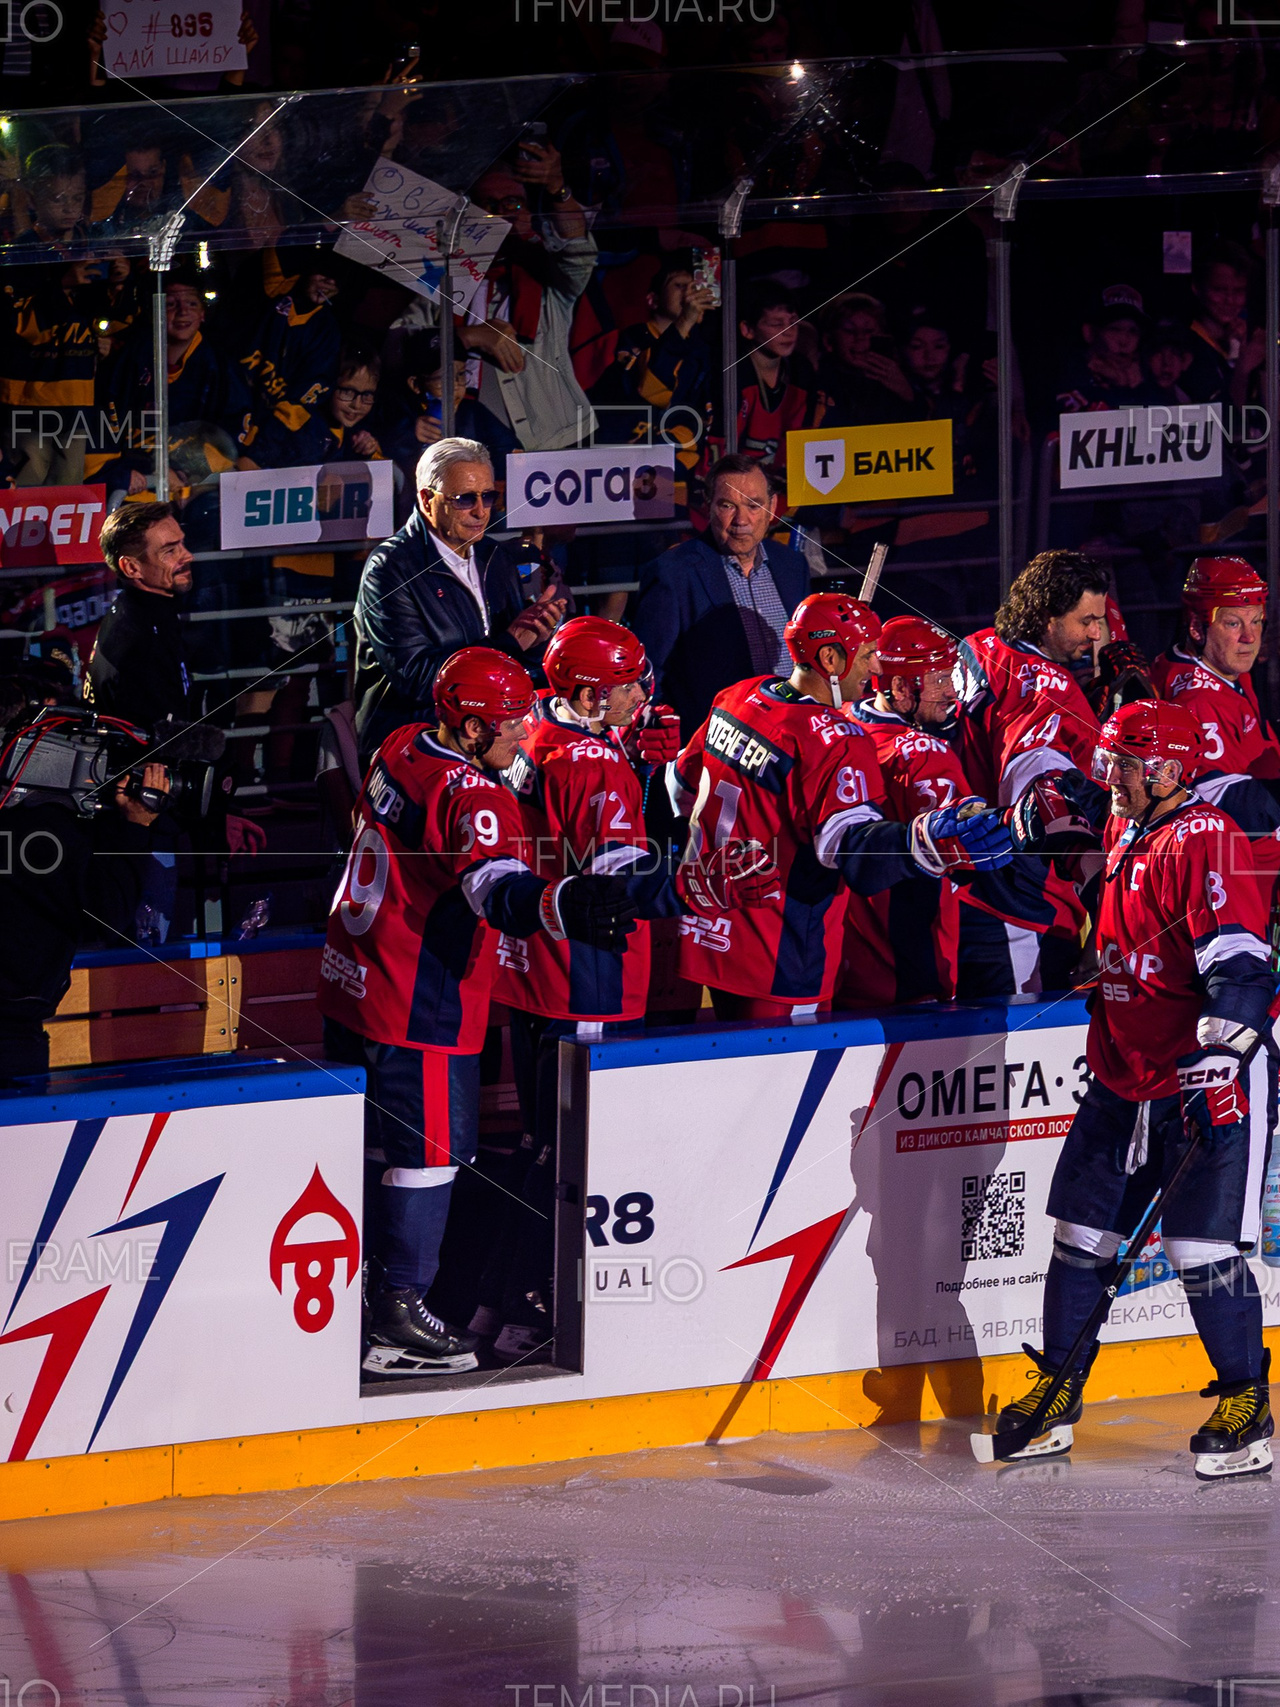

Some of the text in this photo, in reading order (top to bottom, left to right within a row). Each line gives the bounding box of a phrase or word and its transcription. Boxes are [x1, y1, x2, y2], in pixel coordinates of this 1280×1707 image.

[142, 10, 213, 41] #895
[111, 43, 233, 72] ДАЙ ШАЙБУ
[1069, 421, 1215, 470] KHL.RU
[853, 446, 936, 476] БАНК
[245, 487, 370, 526] SIBUR
[574, 674, 600, 682] CCM
[460, 700, 486, 708] CCM
[820, 722, 865, 746] FON
[1167, 743, 1190, 751] CCM
[572, 745, 620, 764] FON
[900, 737, 948, 761] FON
[836, 766, 869, 804] 81
[589, 791, 632, 833] 72
[458, 809, 499, 852] 39
[1175, 817, 1225, 843] FON
[1205, 870, 1227, 911] 8
[1177, 1066, 1231, 1088] CCM
[900, 1135, 915, 1149] ИЗ
[917, 1130, 962, 1149] ДИКОГО
[965, 1121, 1046, 1142] КАМЧАТСКОГО
[935, 1277, 1000, 1294] Подробнее
[1002, 1276, 1016, 1286] на
[947, 1323, 975, 1343] НЕ
